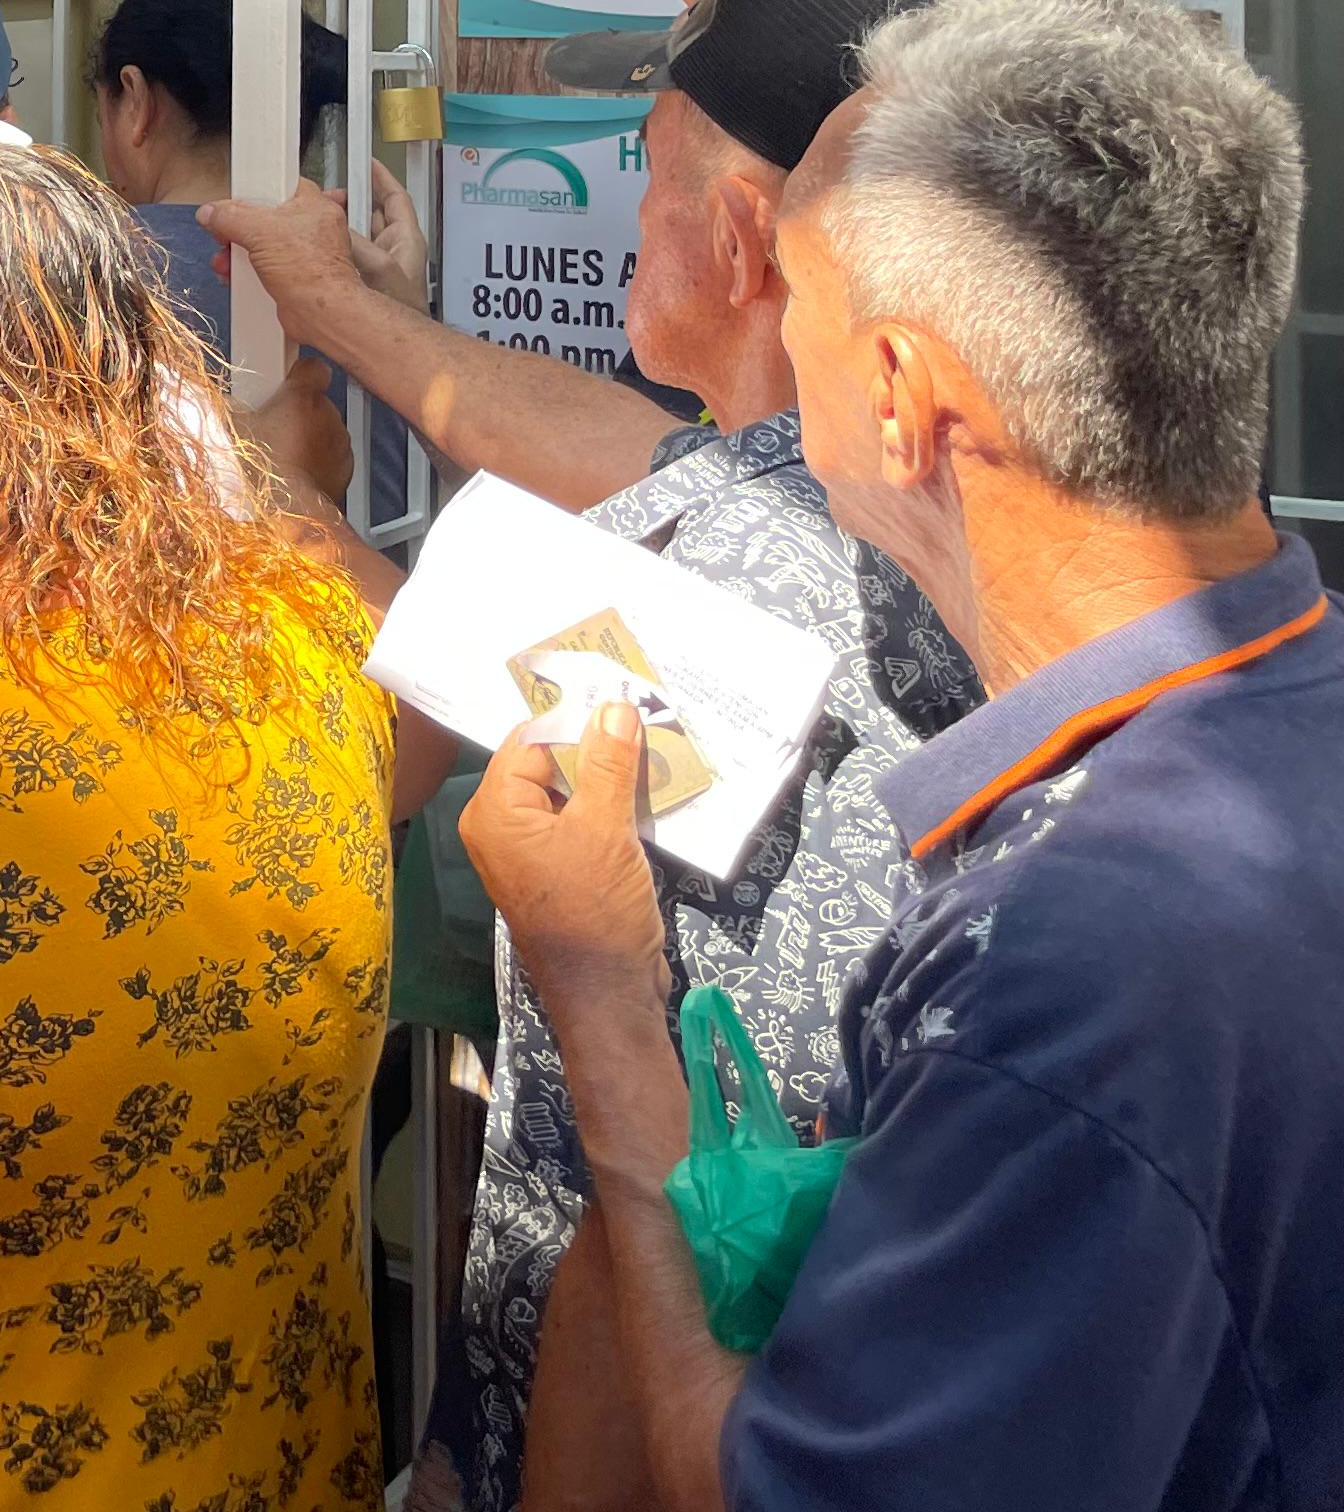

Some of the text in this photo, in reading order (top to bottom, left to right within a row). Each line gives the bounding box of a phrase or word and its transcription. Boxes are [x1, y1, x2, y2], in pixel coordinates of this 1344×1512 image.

[619, 135, 644, 172] H
[460, 181, 575, 208] Pharmasan
[484, 243, 604, 287] LUNES
[472, 284, 626, 330] 8:00 a.m.
